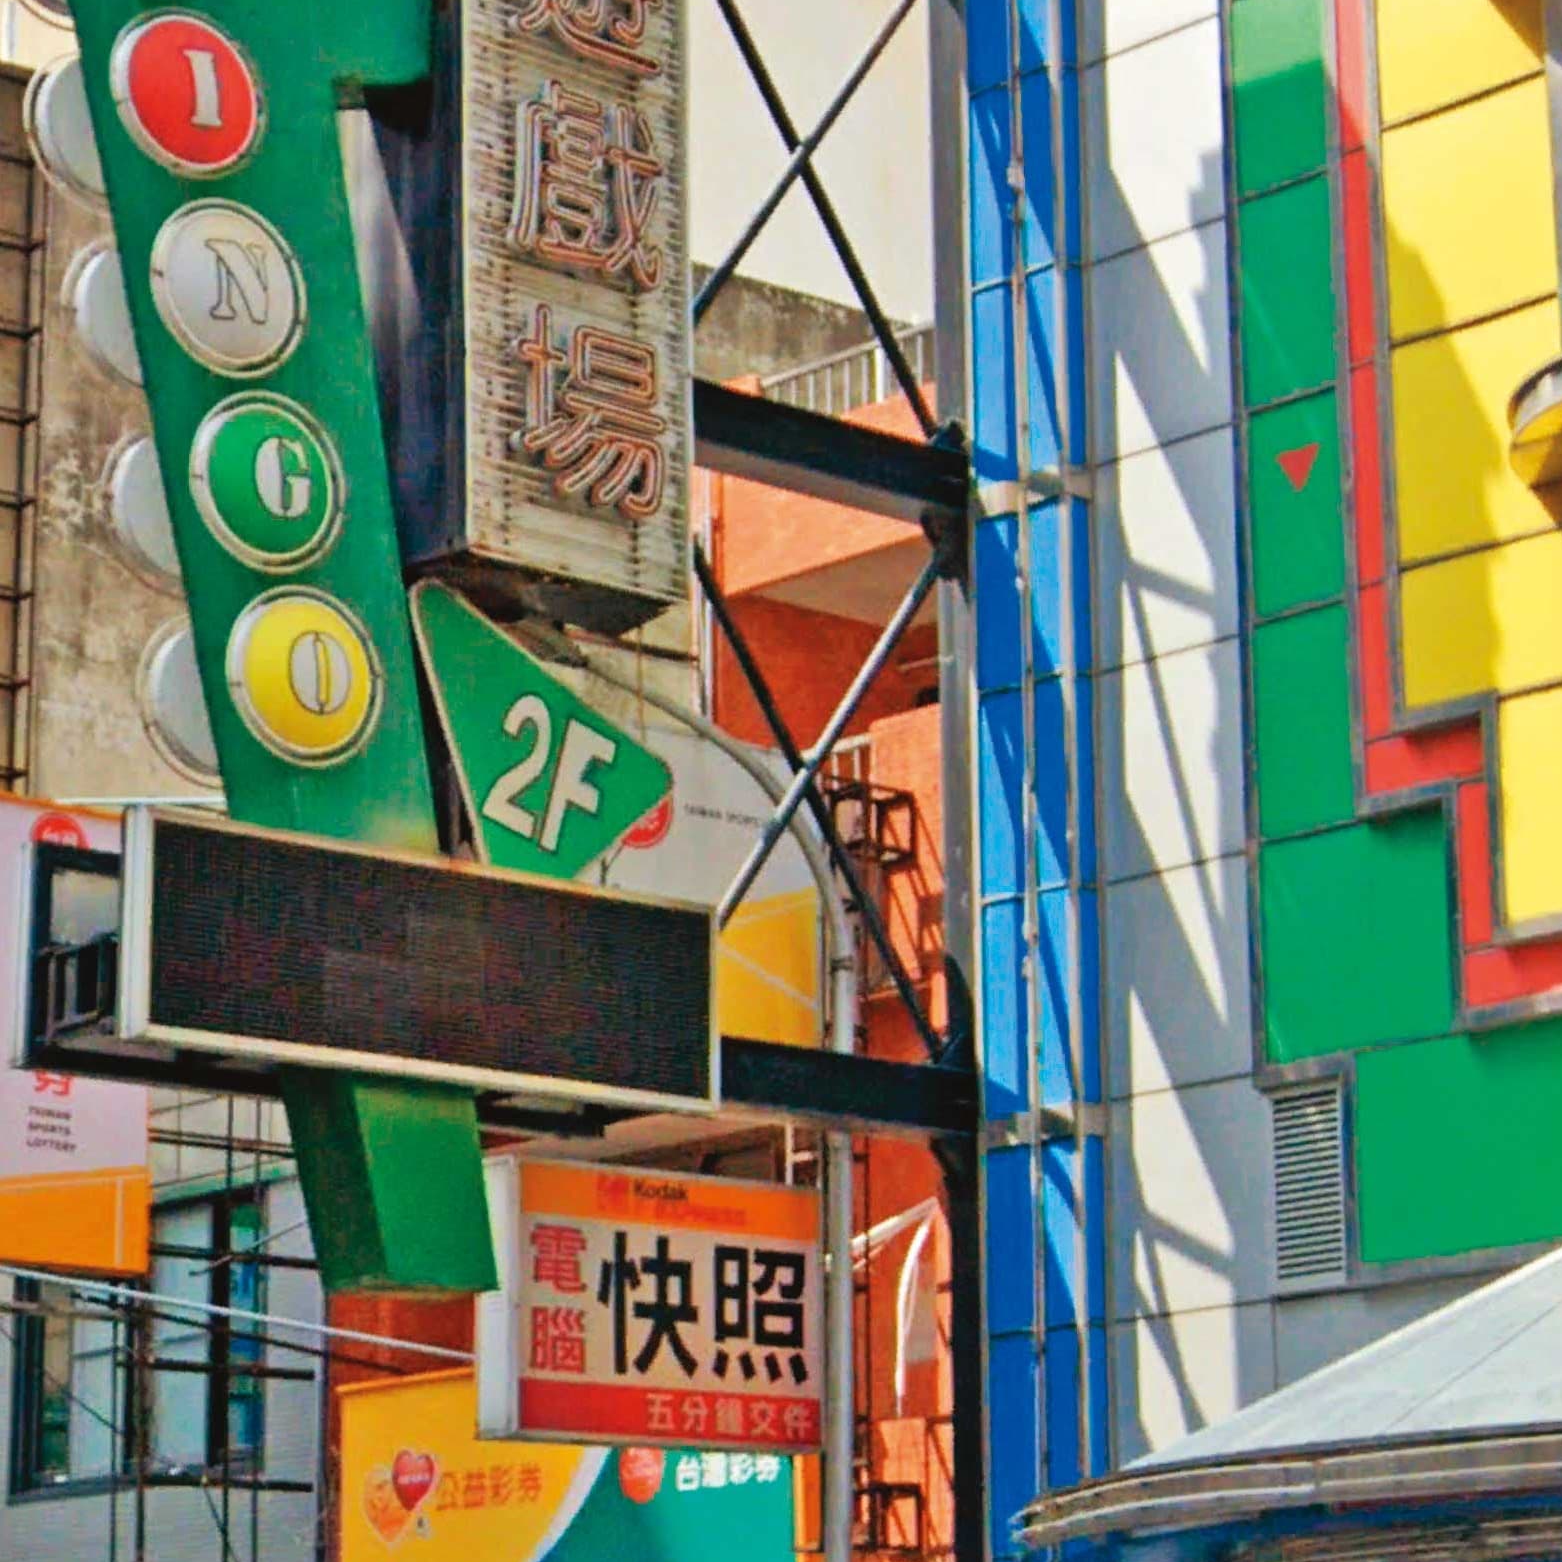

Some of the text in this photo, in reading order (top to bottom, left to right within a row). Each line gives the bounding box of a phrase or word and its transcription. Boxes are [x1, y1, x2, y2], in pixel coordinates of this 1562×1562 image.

[481, 693, 617, 854] 2F
[25, 1137, 76, 1153] LOTTERY
[633, 1178, 688, 1202] Kodak
[531, 1223, 587, 1375] 電腦
[597, 1229, 809, 1386] 快照
